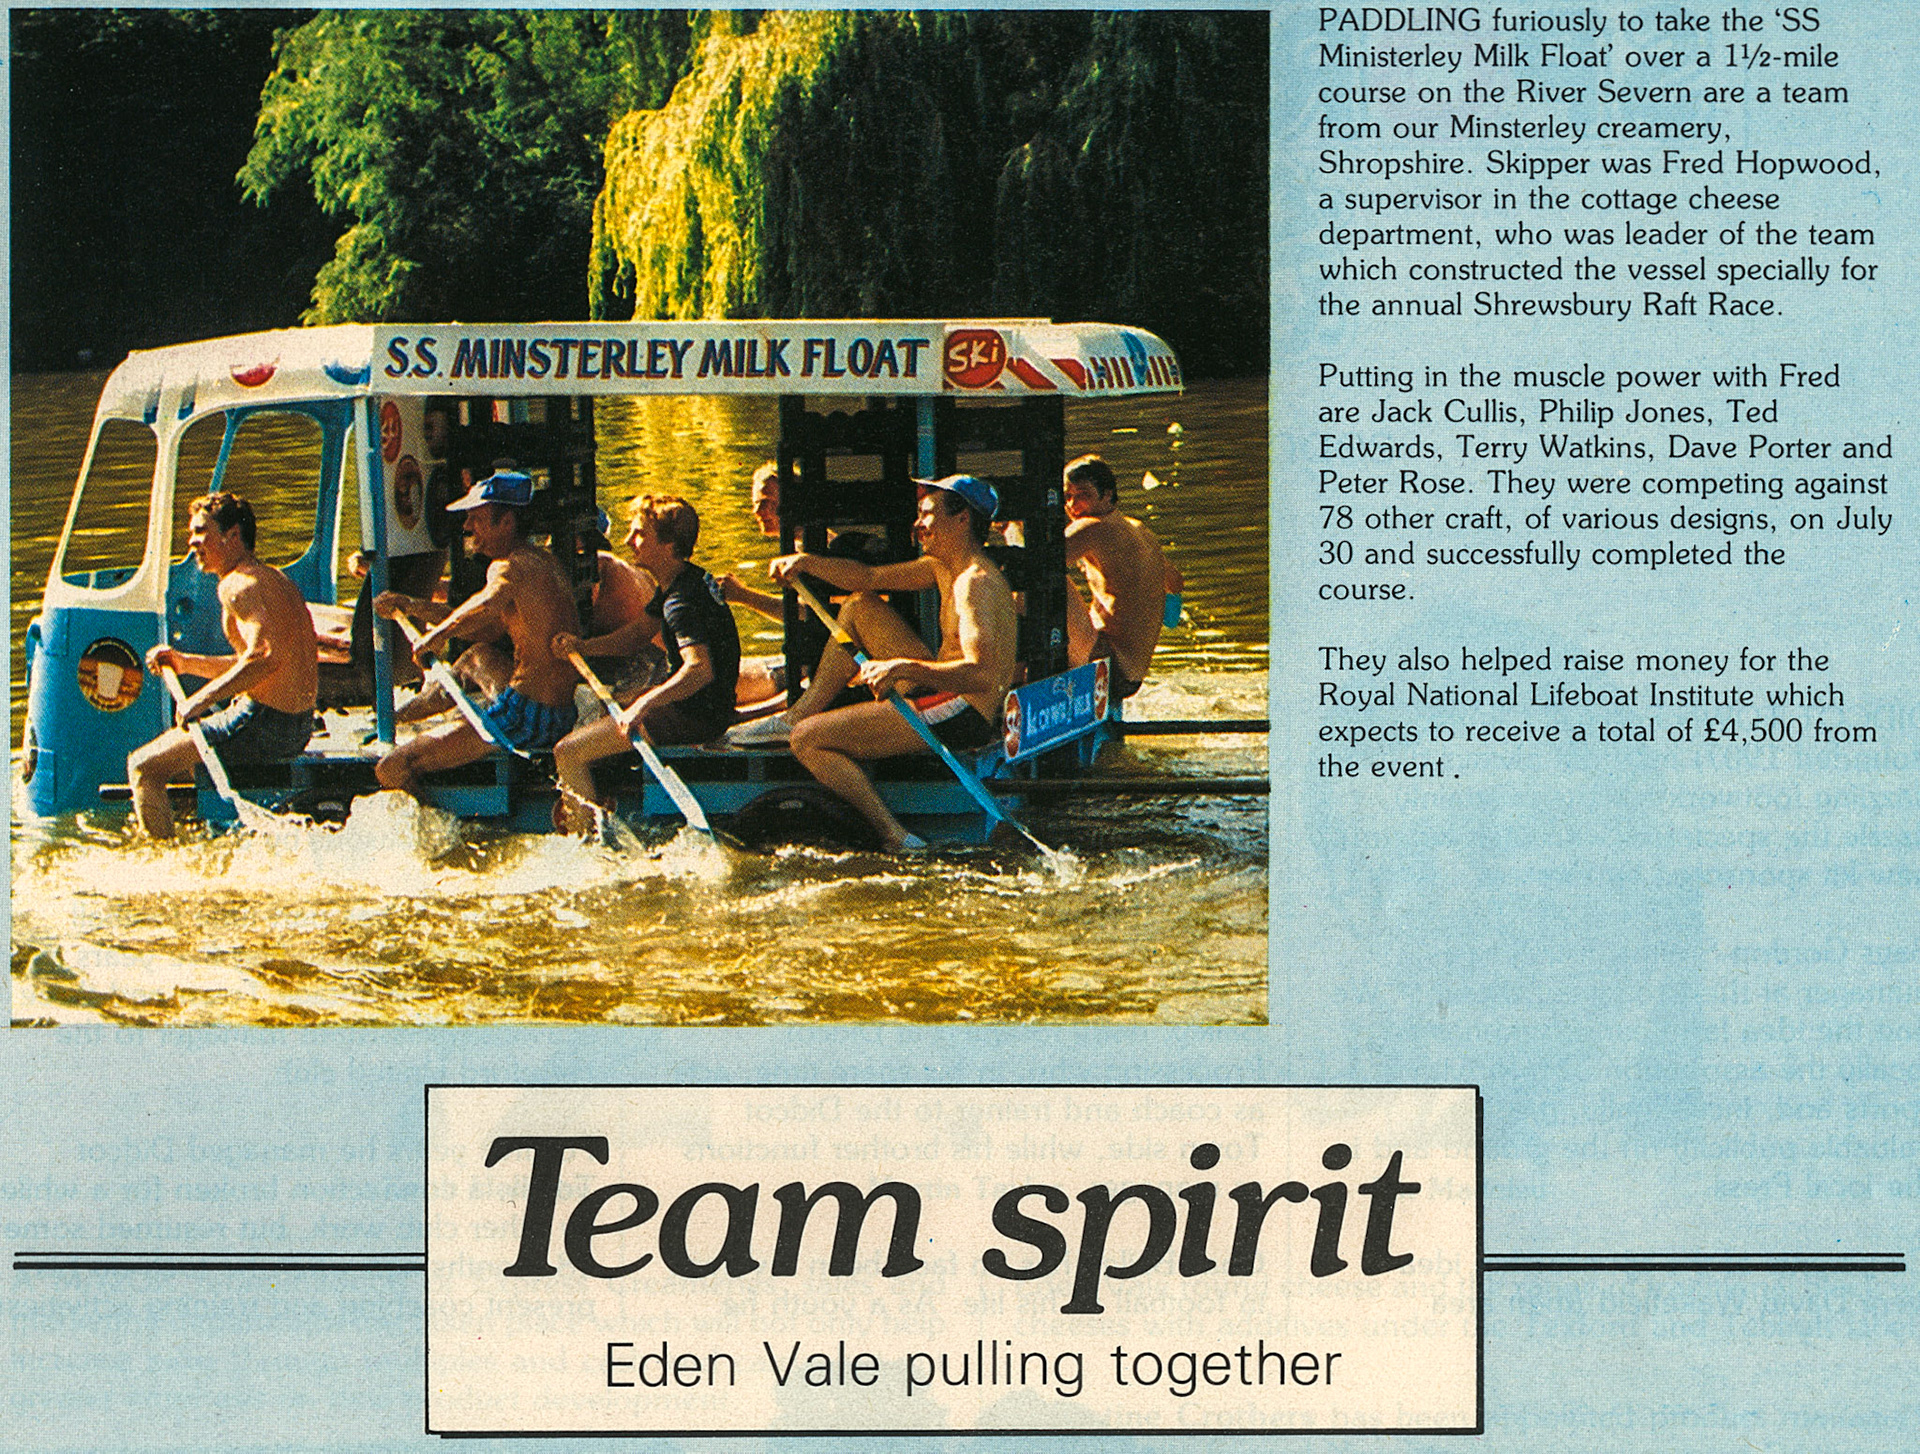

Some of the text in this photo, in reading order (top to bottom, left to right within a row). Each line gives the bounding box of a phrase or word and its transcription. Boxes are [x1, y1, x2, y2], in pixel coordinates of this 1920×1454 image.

[1319, 7, 1481, 32] PADDLING
[1492, 7, 1607, 38] furiously
[1618, 11, 1644, 32] to
[1655, 7, 1710, 32] take
[1721, 7, 1764, 32] the
[1319, 42, 1462, 74] Ministerley
[1474, 42, 1530, 67] Milk
[1625, 51, 1686, 68] over
[1696, 50, 1711, 68] a
[1318, 78, 1849, 104] course on the River Severn are a team
[1318, 113, 1730, 145] from our Minsterley creamery,
[1318, 149, 1880, 180] Shropshire. Skipper was Fred Hopwood,
[1318, 184, 1780, 216] a supervisor in the cottage cheese
[1319, 220, 1875, 251] department, who was leader of the team
[1319, 255, 1879, 287] which constructed the vessel specially for
[1318, 291, 1783, 322] the annual Shrewsbury Raft Race.
[384, 336, 931, 379] S.S. MINSTERLEY MILK FLOAT
[1319, 362, 1840, 393] Putting in the muscle power with Fred
[1318, 398, 1778, 429] are Jack Cullis, Philip Jones, Ted
[1319, 433, 1893, 465] Edwards, Terry Watkins, Dave Porter and
[1319, 469, 1888, 500] Peter Rose. They were competing against
[1319, 504, 1893, 536] 78 other craft, of various designs, on July
[1319, 539, 1785, 571] 30 and successfully completed the
[1318, 583, 1414, 601] course.
[1318, 645, 1829, 677] They also helped raise money for the
[1319, 681, 1845, 712] Royal National Lifeboat Institute which
[1318, 717, 1877, 748] expects to receive a total of £4,500 from
[1318, 752, 1360, 778] the
[484, 1136, 1422, 1315] Team spirit
[607, 1339, 1342, 1398] Eden Vale pulling together
